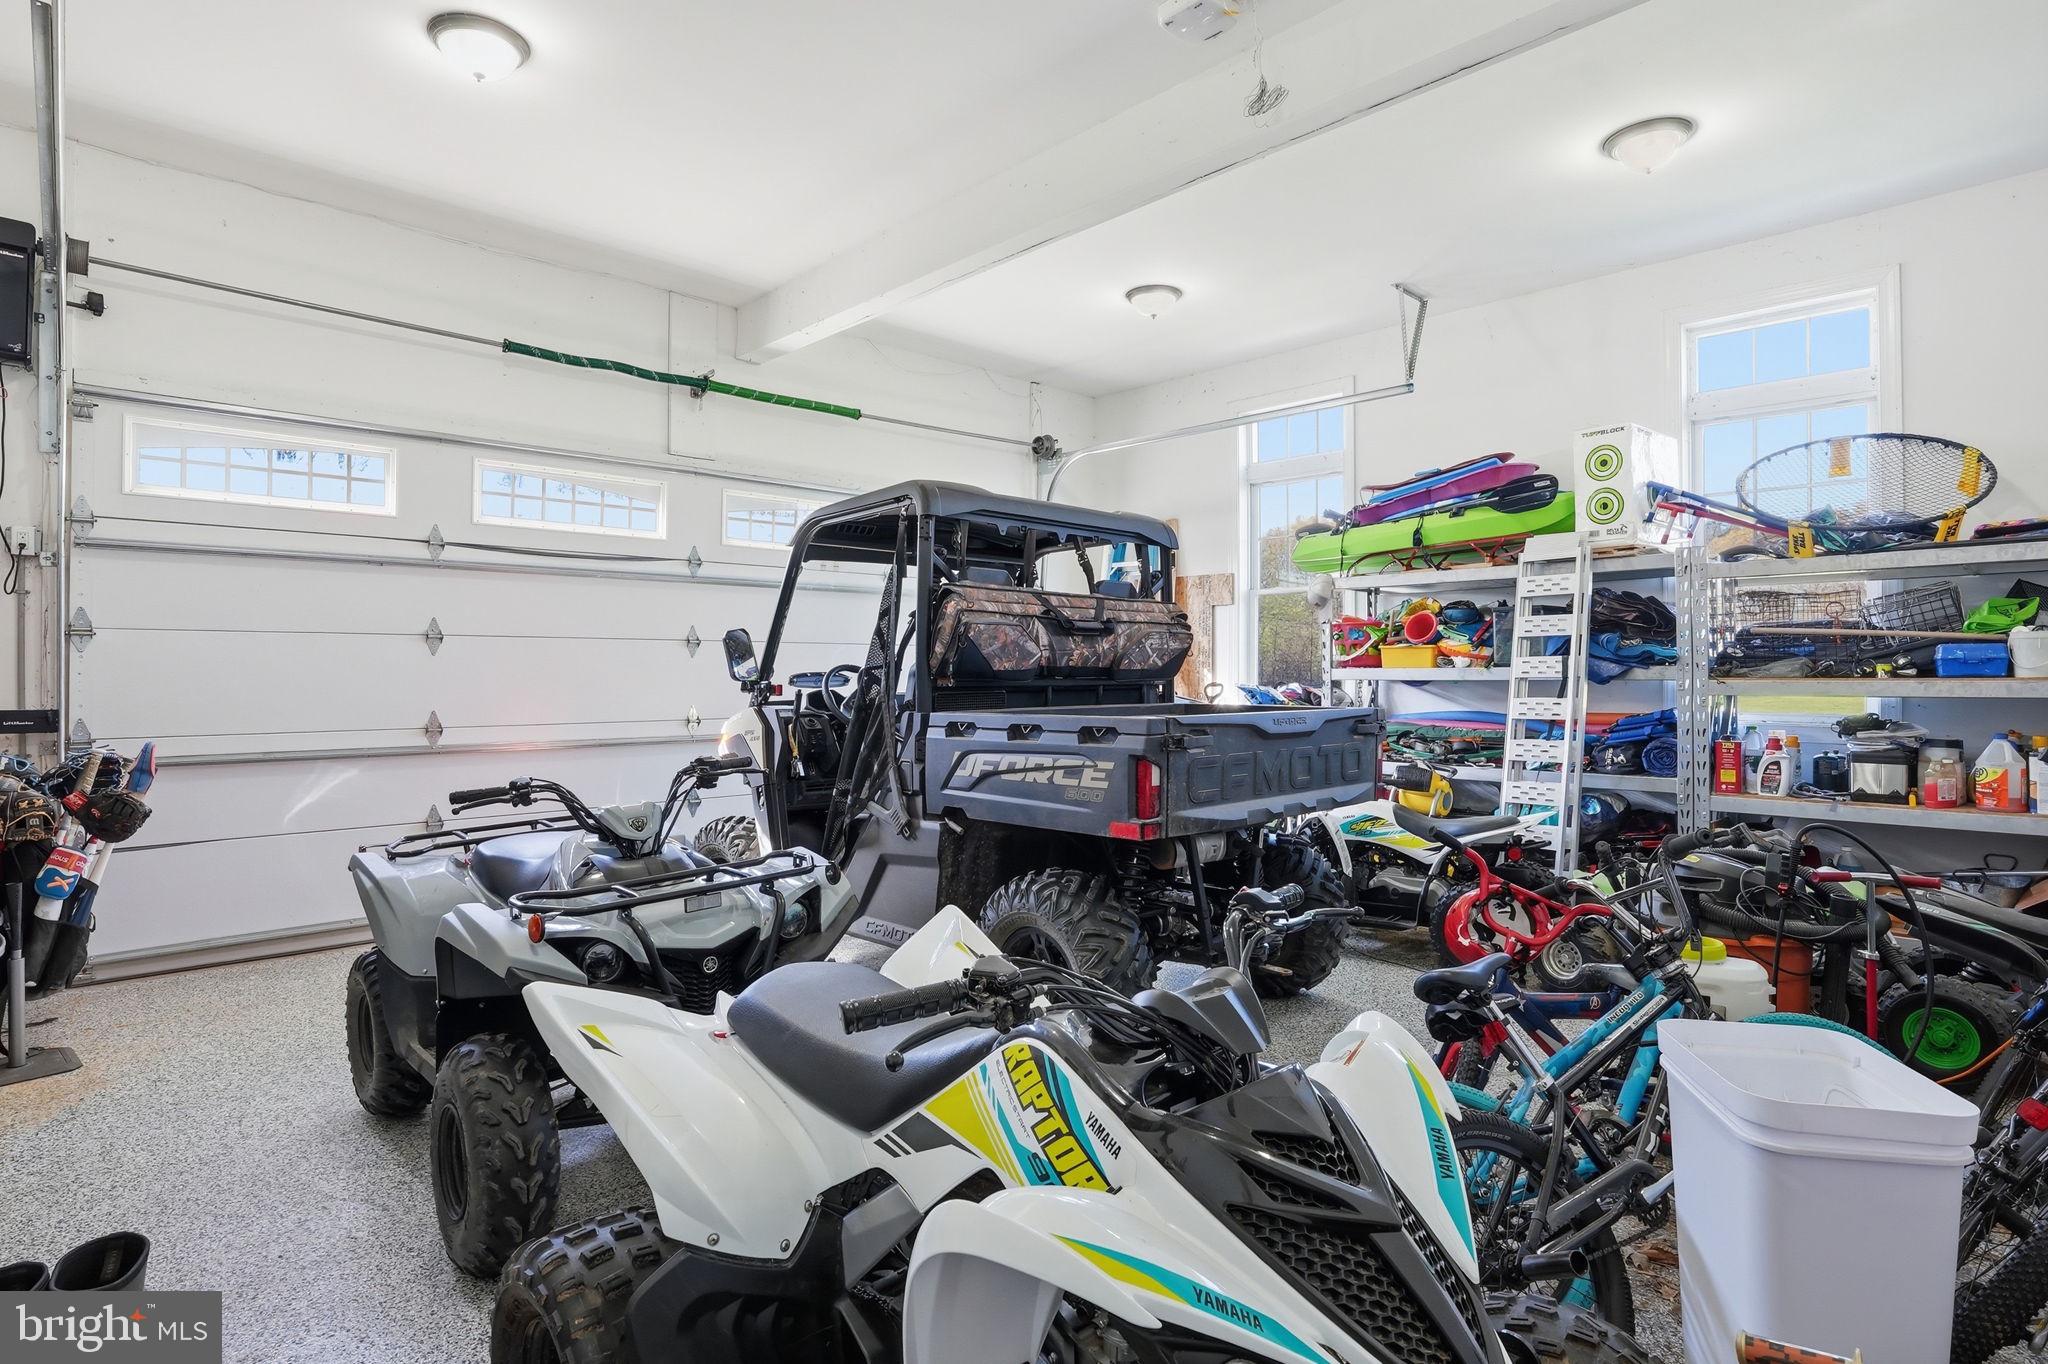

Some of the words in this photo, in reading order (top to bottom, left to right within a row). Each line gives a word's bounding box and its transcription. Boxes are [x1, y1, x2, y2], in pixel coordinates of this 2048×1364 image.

[950, 751, 1115, 789] UFORCE
[1187, 741, 1361, 804] CFMOTO
[1001, 1043, 1113, 1194] RAPTOR
[1084, 1110, 1122, 1160] YAMAHA
[1430, 1126, 1456, 1180] YAMAHA
[1191, 1285, 1265, 1334] YAMAHA
